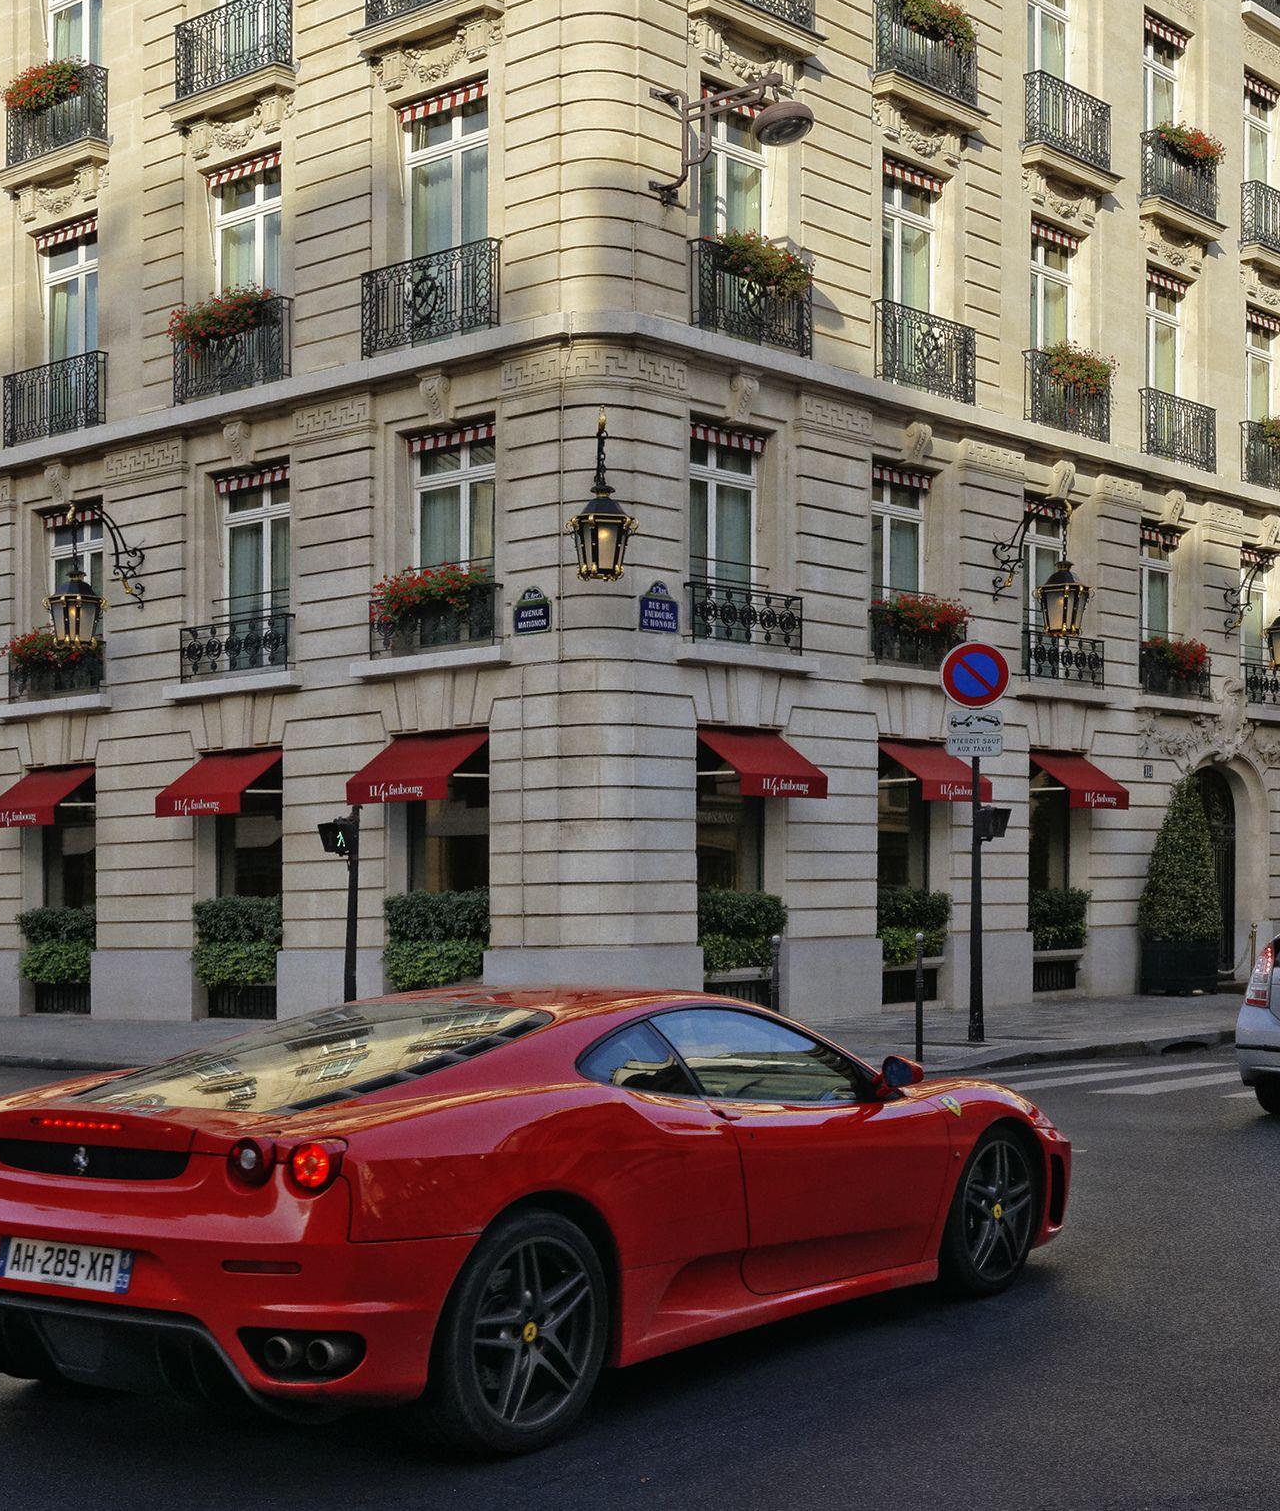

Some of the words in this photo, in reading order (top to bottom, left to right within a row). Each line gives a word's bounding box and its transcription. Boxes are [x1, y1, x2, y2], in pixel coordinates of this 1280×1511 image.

[648, 601, 660, 610] RUE
[520, 608, 544, 618] AVENUE
[644, 610, 674, 620] FAUBOURG
[518, 619, 547, 628] MATIGNON
[650, 619, 677, 630] HONORÉ
[389, 784, 423, 796] faubourg
[780, 778, 809, 794] faubourg
[954, 784, 972, 796] faubou
[190, 800, 220, 812] faubourg
[116, 1273, 128, 1288] 59
